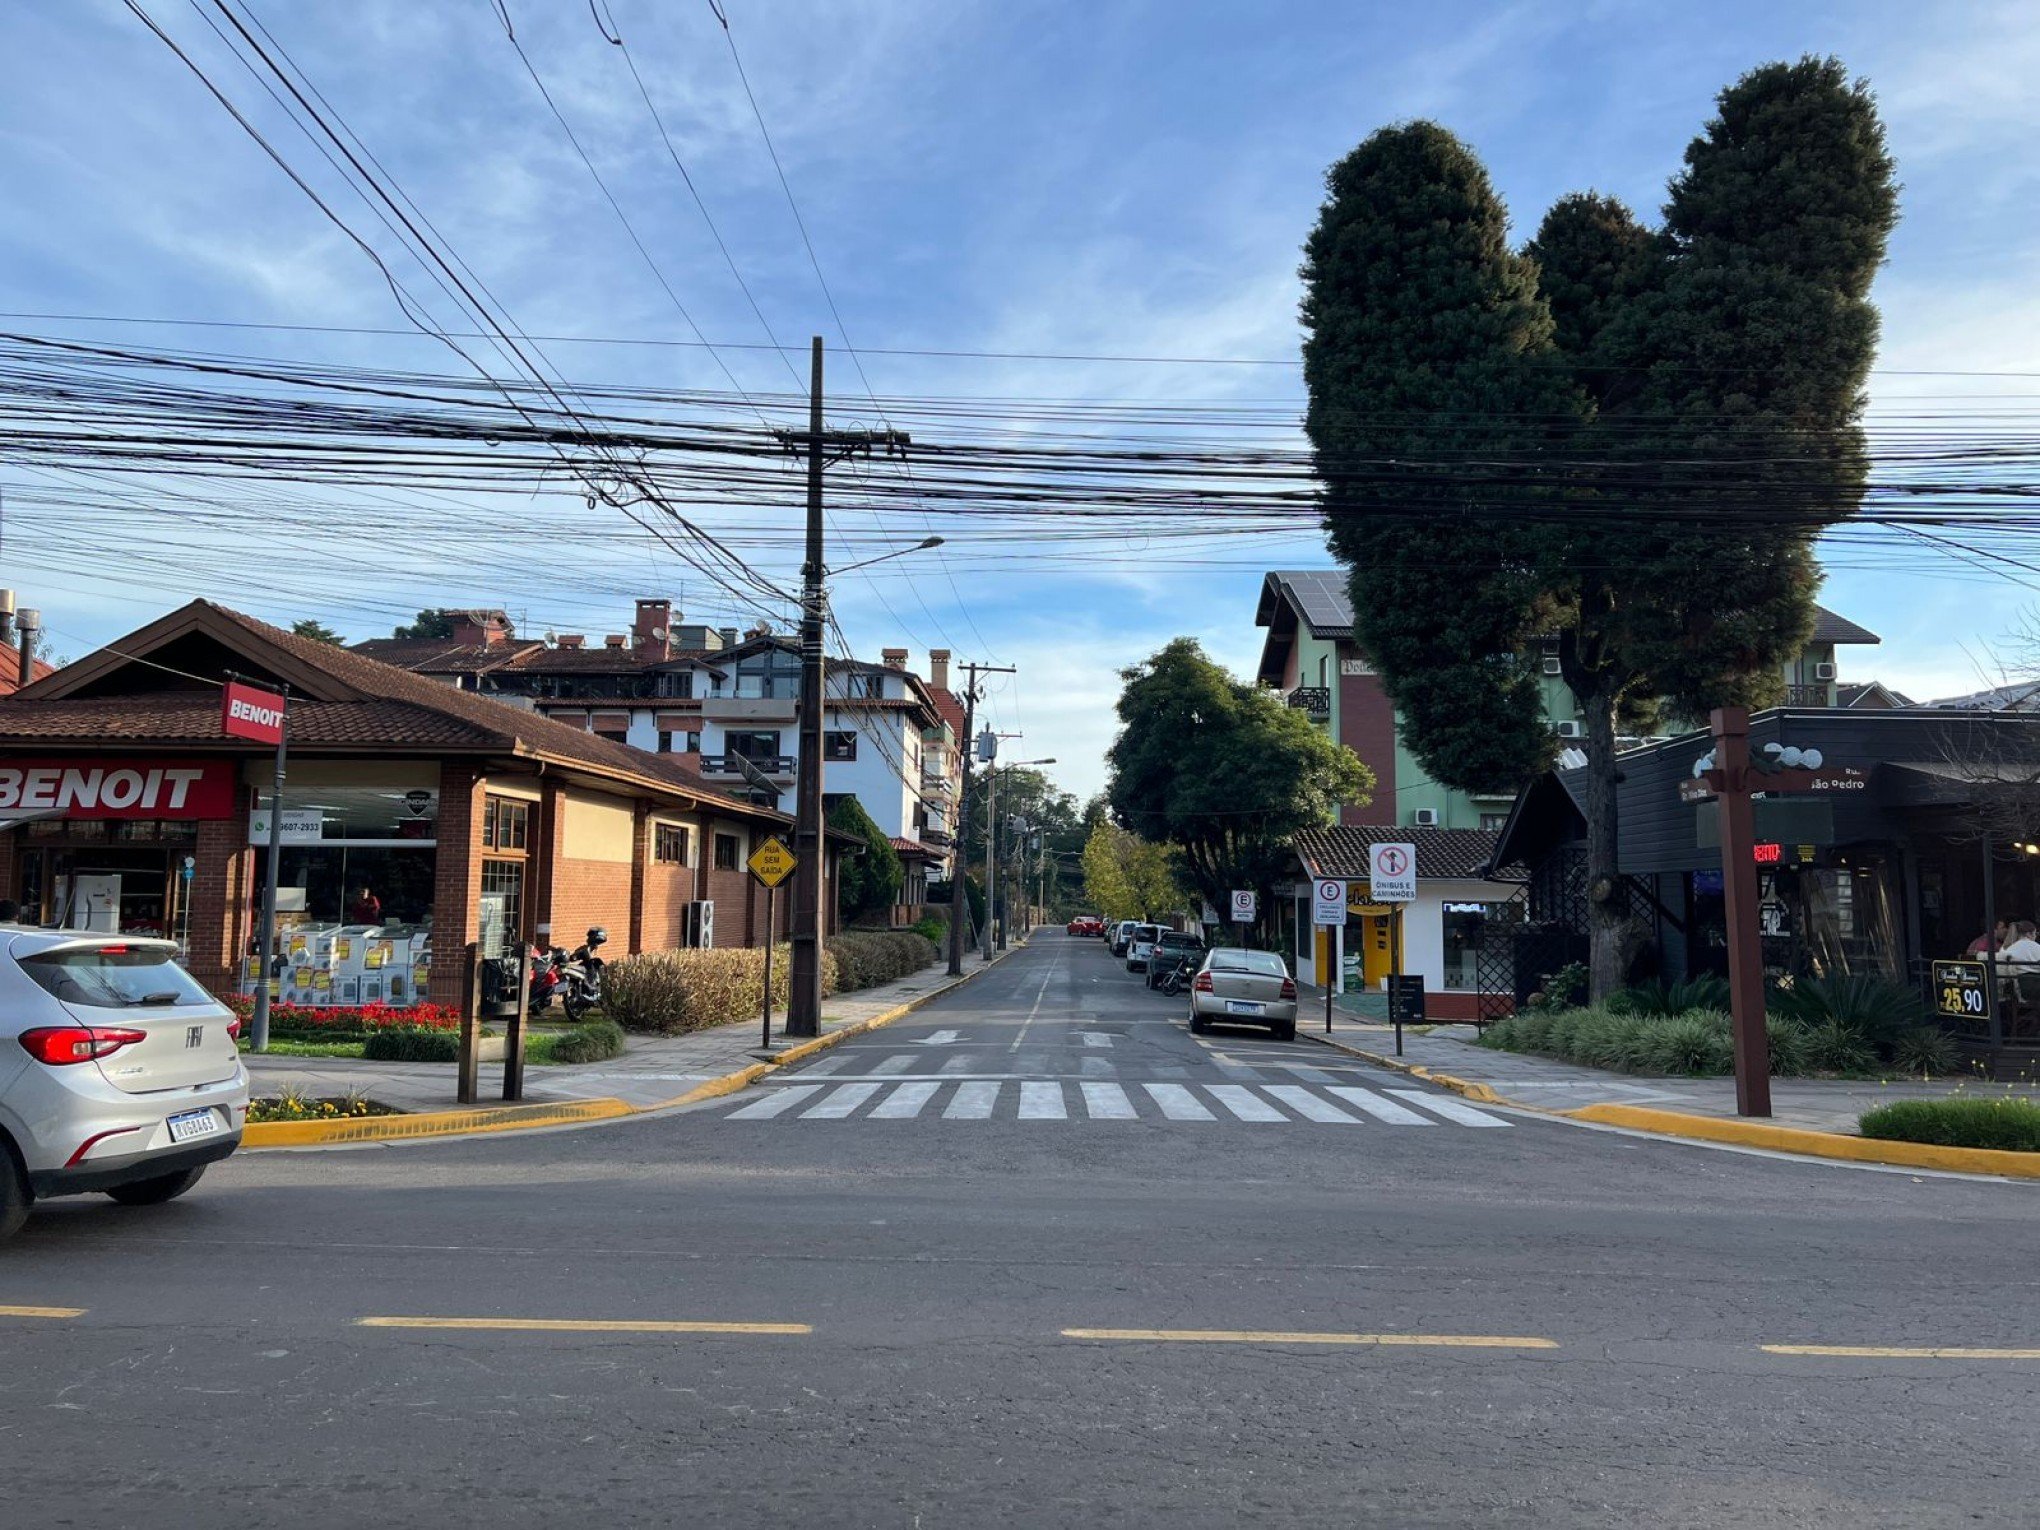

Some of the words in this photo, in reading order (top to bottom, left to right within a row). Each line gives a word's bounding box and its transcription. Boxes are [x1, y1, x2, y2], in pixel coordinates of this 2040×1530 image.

[229, 699, 284, 728] BENOIT
[0, 768, 204, 809] BENOIT
[764, 846, 780, 854] RUA
[1376, 881, 1405, 890] ÔNIBUS
[1405, 882, 1411, 890] E
[1373, 889, 1416, 898] CAMINHÕES
